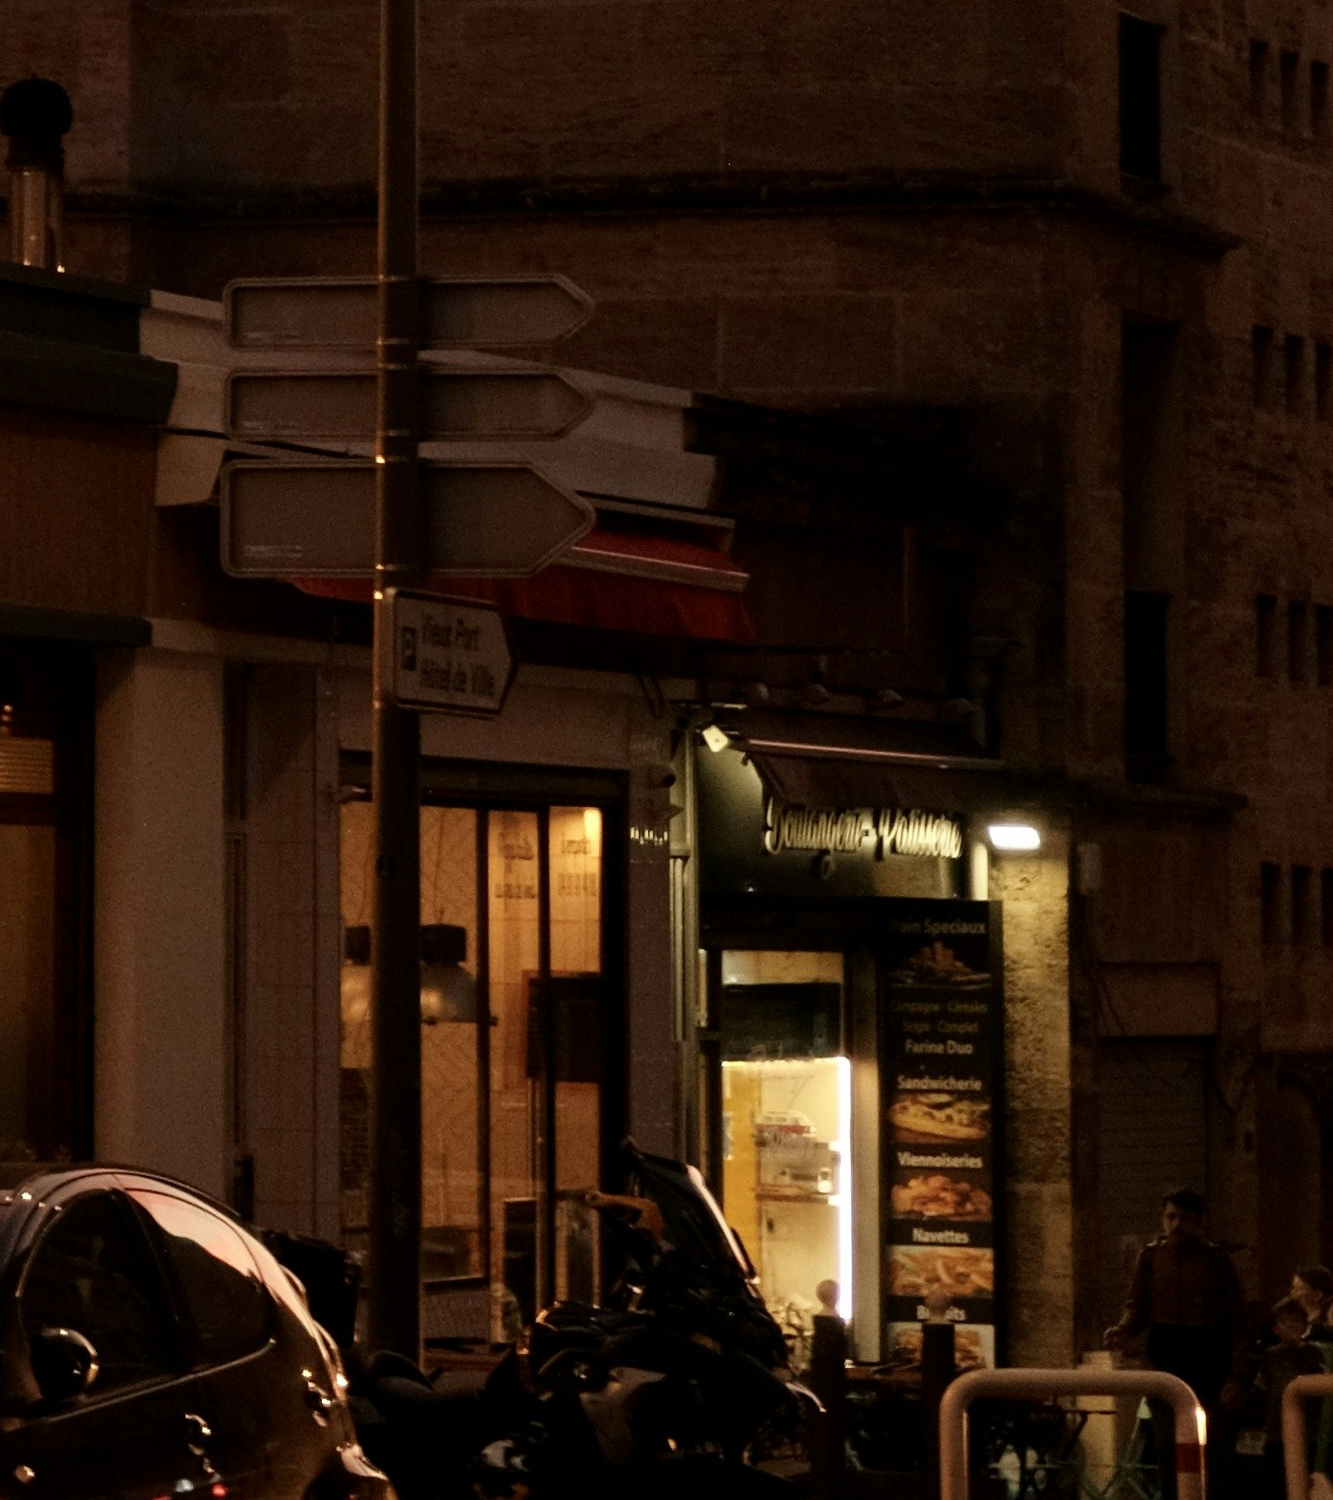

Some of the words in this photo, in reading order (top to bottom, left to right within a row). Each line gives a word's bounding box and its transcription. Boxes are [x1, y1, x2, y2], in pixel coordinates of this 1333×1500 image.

[946, 1038, 974, 1055] Duo
[896, 1073, 983, 1090] Sandwicherie
[896, 1150, 984, 1169] Viennoiseries
[911, 1226, 971, 1245] Navettes
